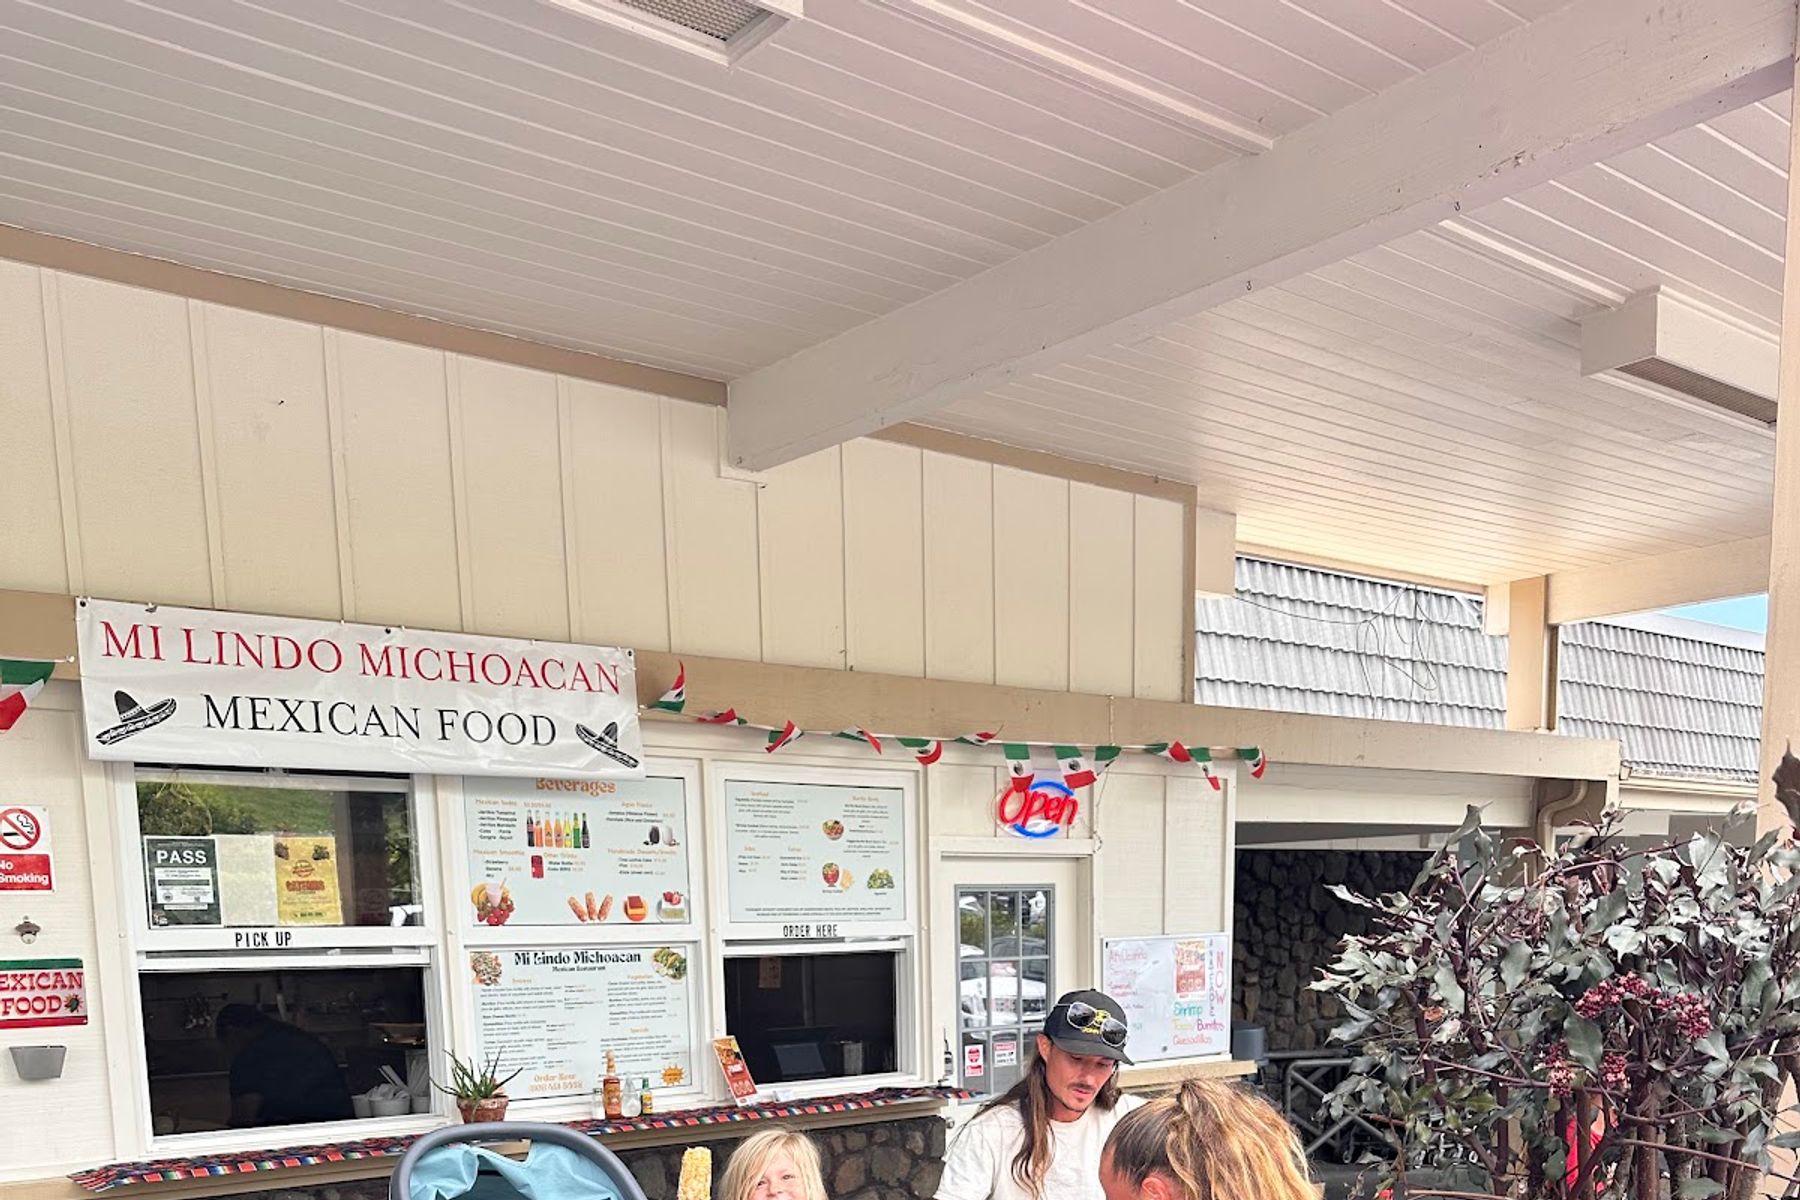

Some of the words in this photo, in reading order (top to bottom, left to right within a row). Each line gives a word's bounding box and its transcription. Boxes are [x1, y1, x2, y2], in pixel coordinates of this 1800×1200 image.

[100, 620, 166, 661] MI
[182, 628, 342, 674] LINDO
[358, 643, 621, 695] MICHOACAN
[202, 694, 420, 740] MEXICAN
[436, 708, 557, 747] FOOD
[536, 777, 617, 797] Beverages
[999, 787, 1079, 828] Open
[156, 849, 208, 865] PASS
[0, 872, 49, 887] Smoking
[235, 931, 269, 948] PICK
[275, 931, 292, 947] UP
[783, 924, 811, 938] ORDER
[816, 924, 838, 937] HERE
[514, 951, 531, 966] Mi
[573, 950, 641, 965] Michoacan
[0, 971, 83, 991] EXICAN
[2, 994, 62, 1016] FOOD
